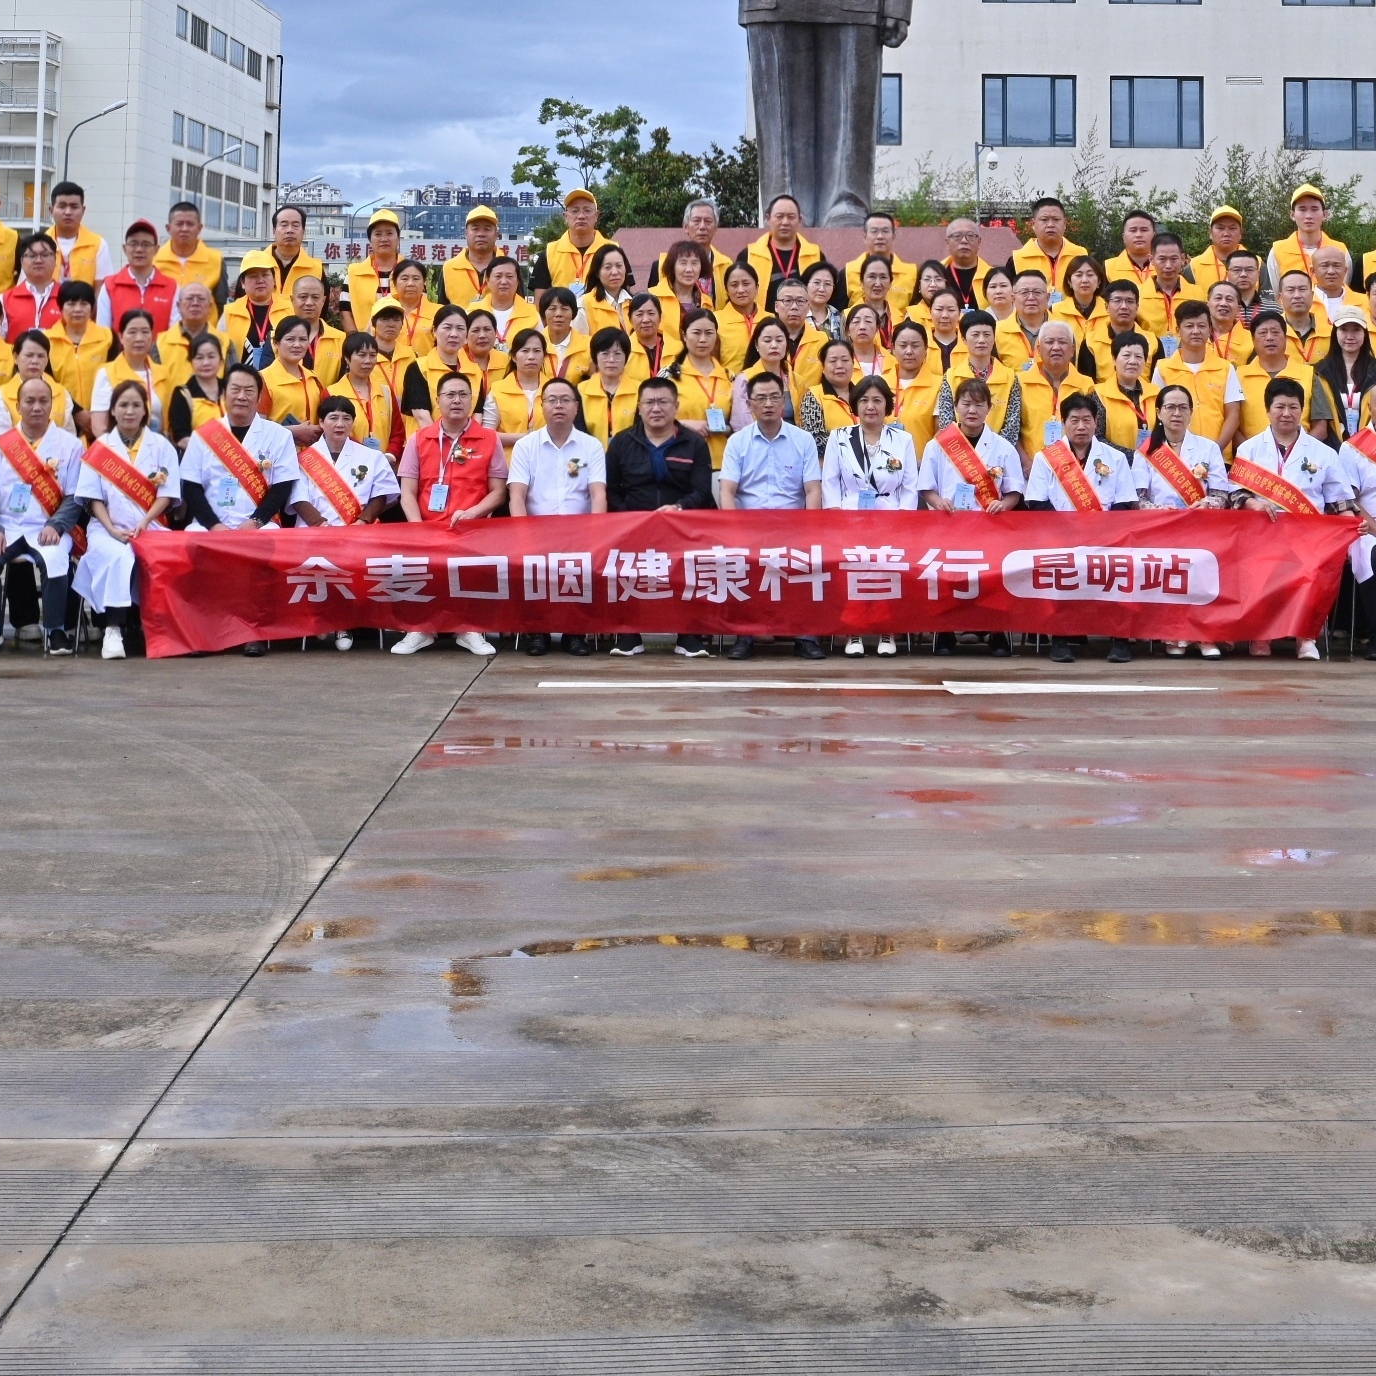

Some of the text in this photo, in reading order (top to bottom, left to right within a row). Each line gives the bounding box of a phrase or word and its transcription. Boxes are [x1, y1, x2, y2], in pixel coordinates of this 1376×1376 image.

[286, 544, 990, 604] 余麦口咽健康科普行
[1028, 549, 1193, 594] 昆明站
